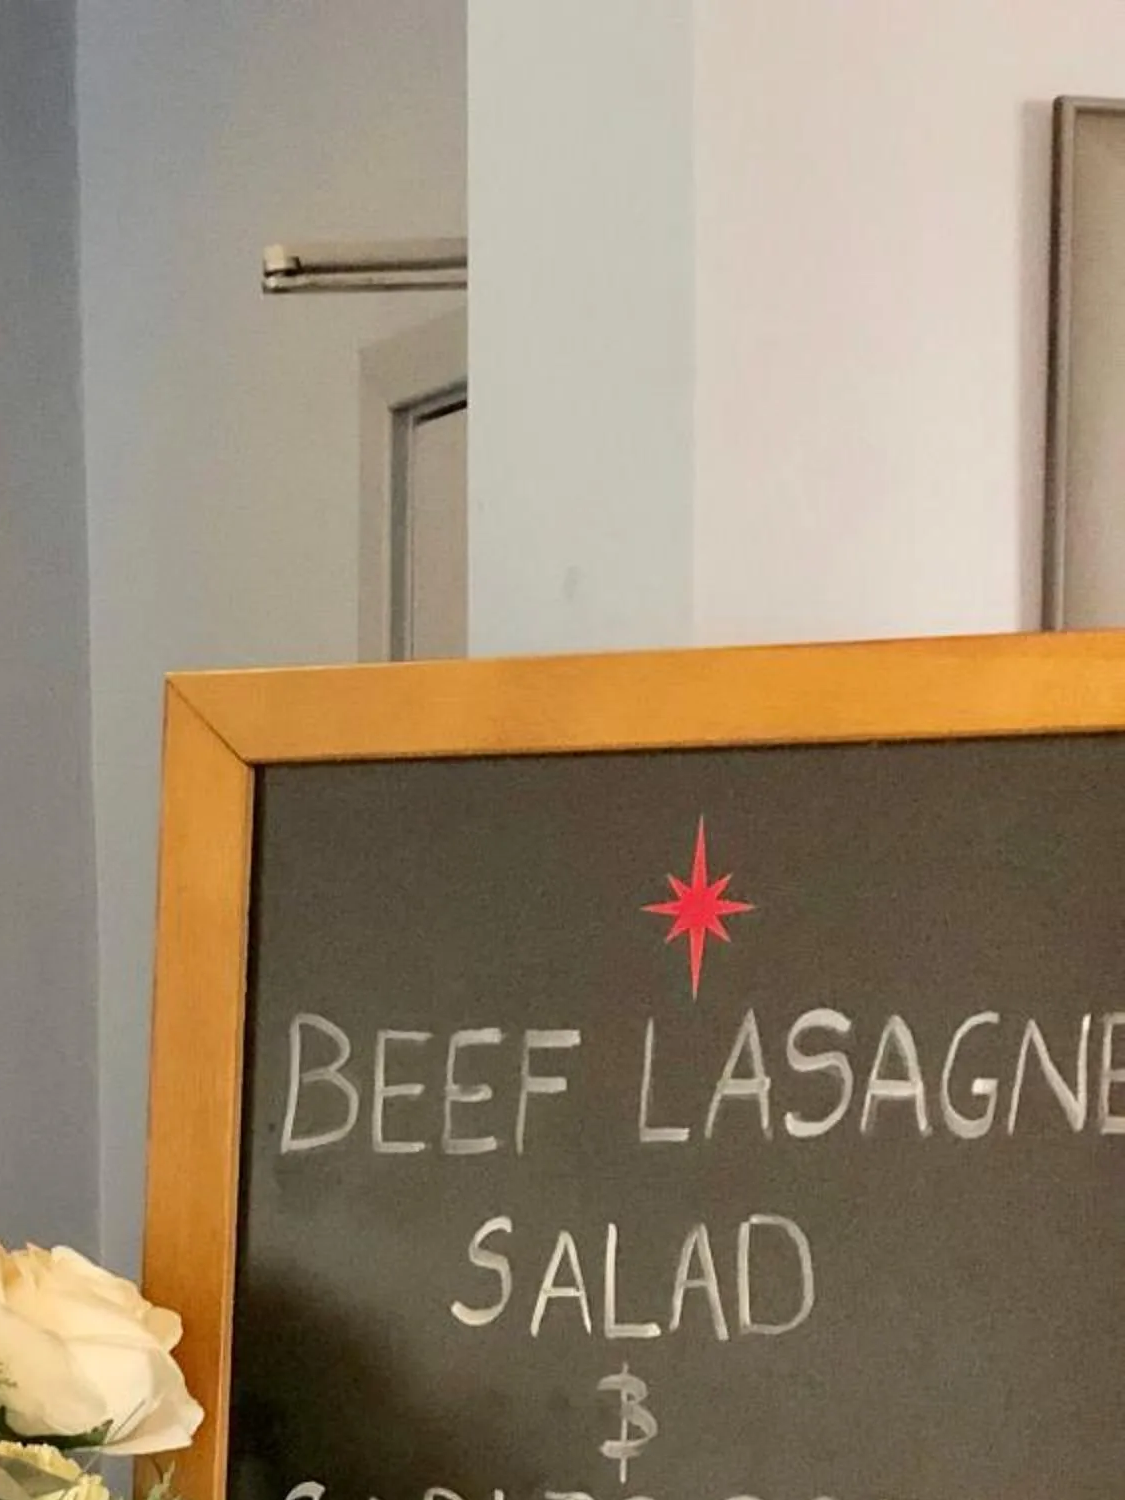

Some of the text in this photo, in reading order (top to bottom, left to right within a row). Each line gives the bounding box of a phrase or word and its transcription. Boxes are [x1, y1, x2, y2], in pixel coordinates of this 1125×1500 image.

[281, 1009, 1125, 1154] BEEF LASAGNE
[450, 1215, 814, 1341] SALAD
